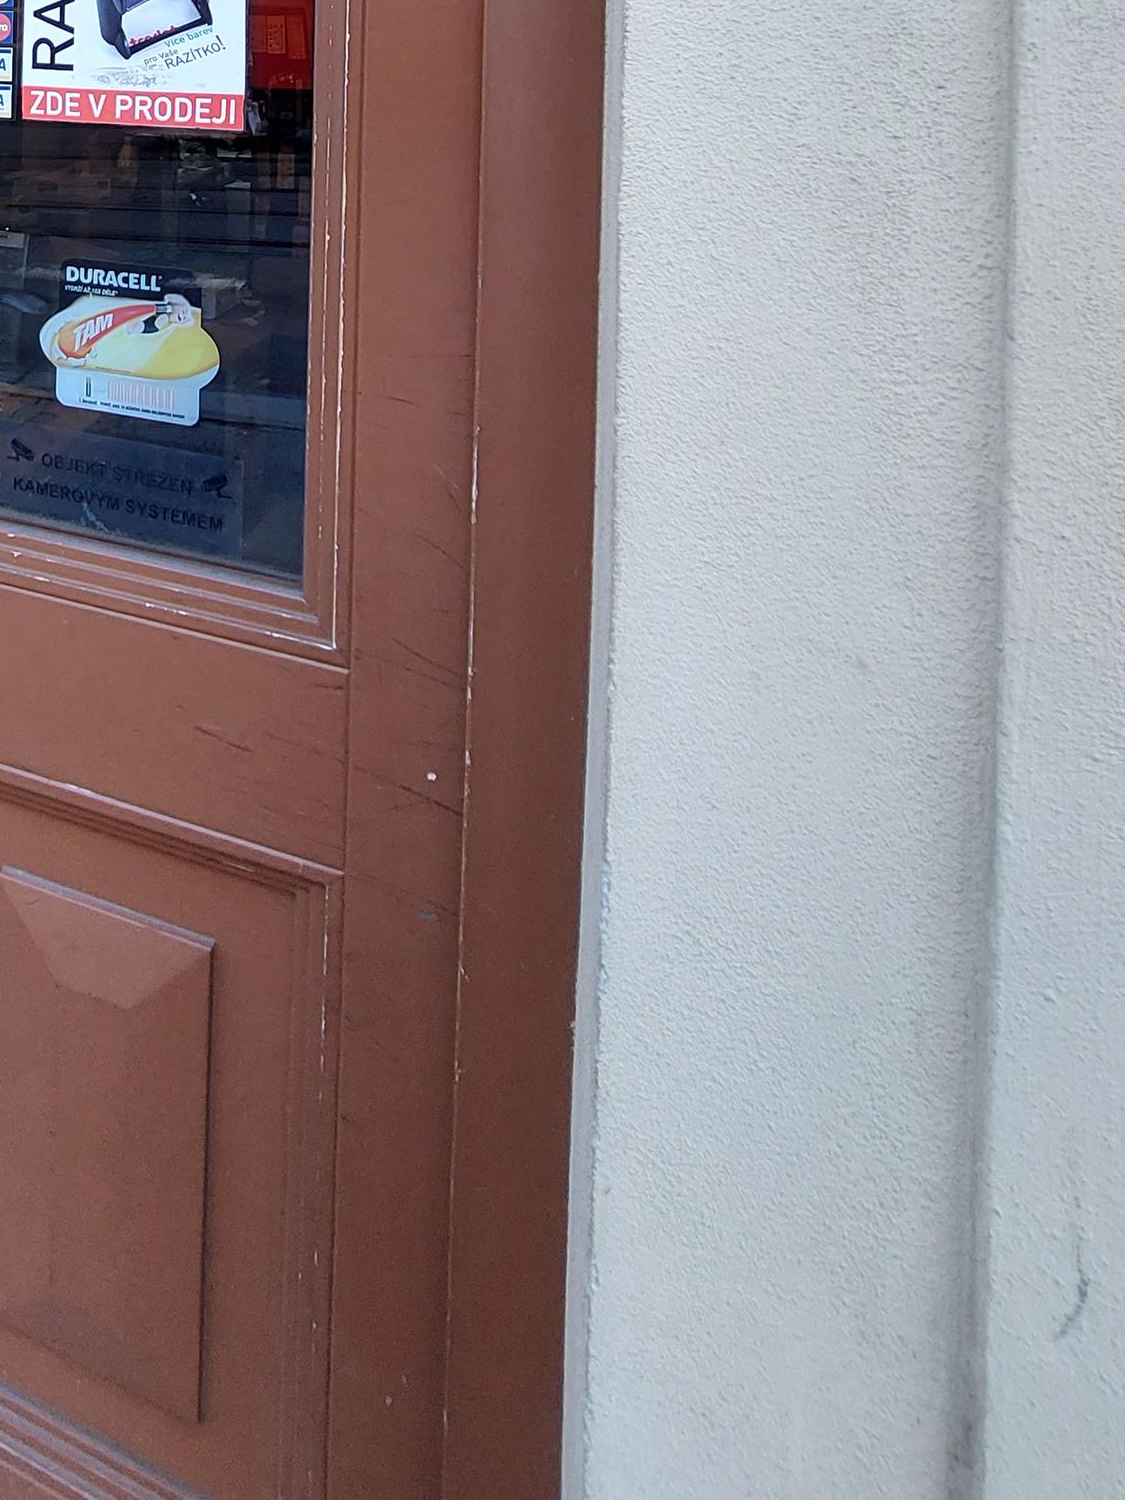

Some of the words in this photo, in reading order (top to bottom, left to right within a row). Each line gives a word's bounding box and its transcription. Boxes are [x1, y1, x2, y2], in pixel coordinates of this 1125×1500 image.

[186, 27, 214, 41] barev
[143, 54, 158, 66] pro
[159, 47, 179, 59] Vaše
[164, 34, 227, 70] RAZÍTKO!
[30, 90, 82, 118] ZDE
[88, 94, 107, 119] V
[115, 95, 236, 125] PRODEJI
[66, 265, 162, 292] DURACELL
[41, 453, 107, 478] OBJEKT
